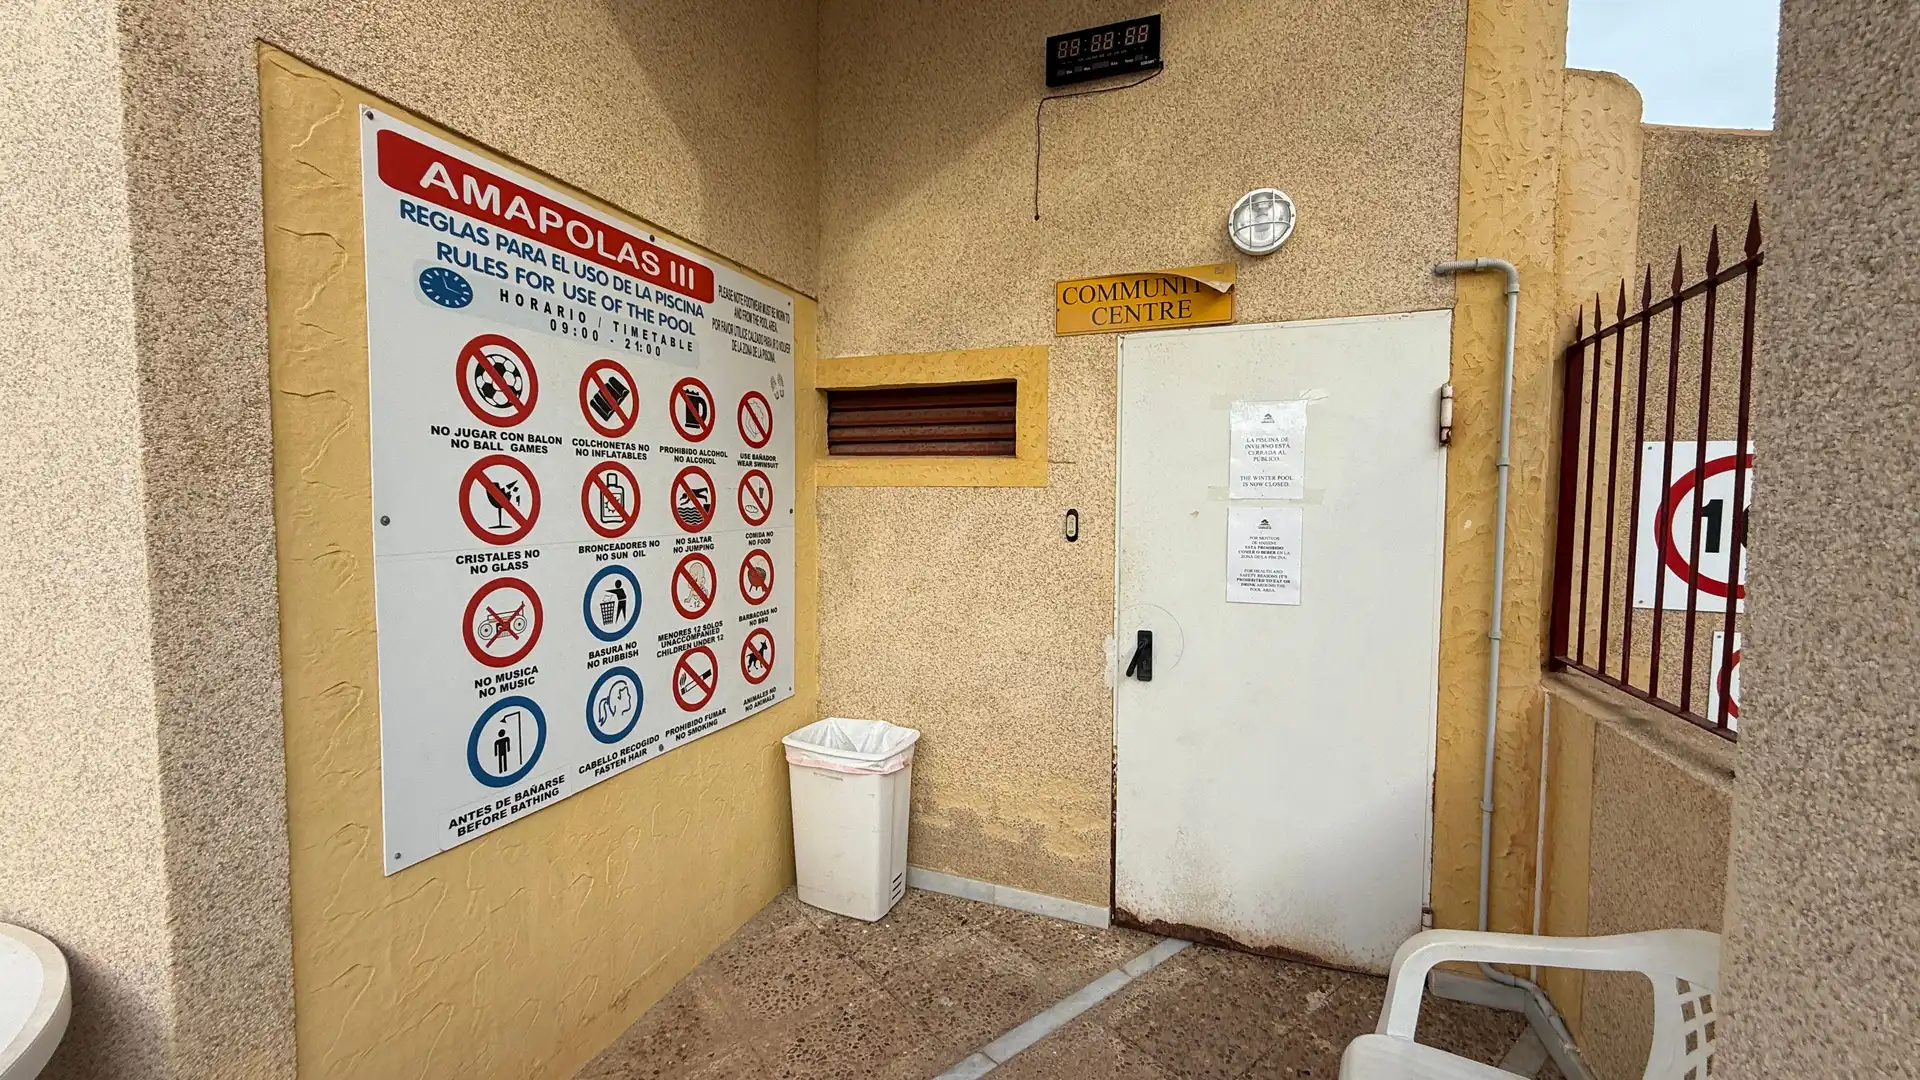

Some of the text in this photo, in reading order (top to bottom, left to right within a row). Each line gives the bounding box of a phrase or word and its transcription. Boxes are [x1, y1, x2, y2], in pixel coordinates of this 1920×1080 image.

[419, 161, 694, 290] AMAPOLAS III
[400, 199, 704, 318] REGLAS PARA EL USO DE LA PISCINA
[436, 241, 696, 336] RULES FOR USE OF THE POOL
[719, 285, 733, 301] PLEASE
[734, 291, 743, 305] NOTE
[1063, 277, 1201, 305] COMMUNIT
[500, 288, 586, 324] HORARIO
[613, 321, 693, 352] TIMETABLE
[742, 309, 752, 323] FROM
[1092, 300, 1192, 325] CENTRE
[712, 318, 720, 331] POR
[550, 318, 599, 342] 09:00
[625, 338, 661, 356] 21:00
[732, 339, 737, 352] DE
[430, 425, 562, 445] NO JUGAR CON BALON
[572, 438, 650, 452] COLCHONETAS NO
[450, 439, 548, 454] NO BALL GAMES
[576, 448, 647, 460] NO INFLATABLES
[660, 446, 728, 458] PROHIBIDO ALCOHOL
[754, 461, 778, 469] SWIMSUIT
[579, 539, 660, 555] BRONCEADORES NO
[675, 535, 712, 545] NO SALTAR
[685, 543, 715, 552] JUMPING
[455, 549, 540, 565] CRISTALES NO
[596, 550, 646, 562] NO SUN OIL
[470, 560, 529, 575] NO GLASS
[739, 609, 770, 622] BARBACOAS
[749, 616, 768, 627] NO BBQ
[658, 621, 723, 642] MENORES 12 SOLOS
[661, 628, 720, 649] UNACCOMPANIED
[588, 641, 637, 660] BASURA NO
[656, 634, 724, 659] CHILDREN UNDER 12
[587, 649, 639, 670] NO RUBBISH
[474, 665, 539, 688] NO MUSICA
[479, 676, 536, 699] NO MUSIC
[743, 689, 769, 706] ANIMALES
[745, 694, 775, 712] NO ANIMALS
[665, 707, 727, 738] PROHIBIDO FUMAR
[675, 719, 718, 742] NO SMOKING
[579, 734, 659, 774] CABELLO RECOGIDO
[595, 748, 647, 777] FASTEN HAIR
[449, 775, 565, 830] ANTES DE BAÑARSE
[457, 787, 559, 837] BEFORE BATHING
